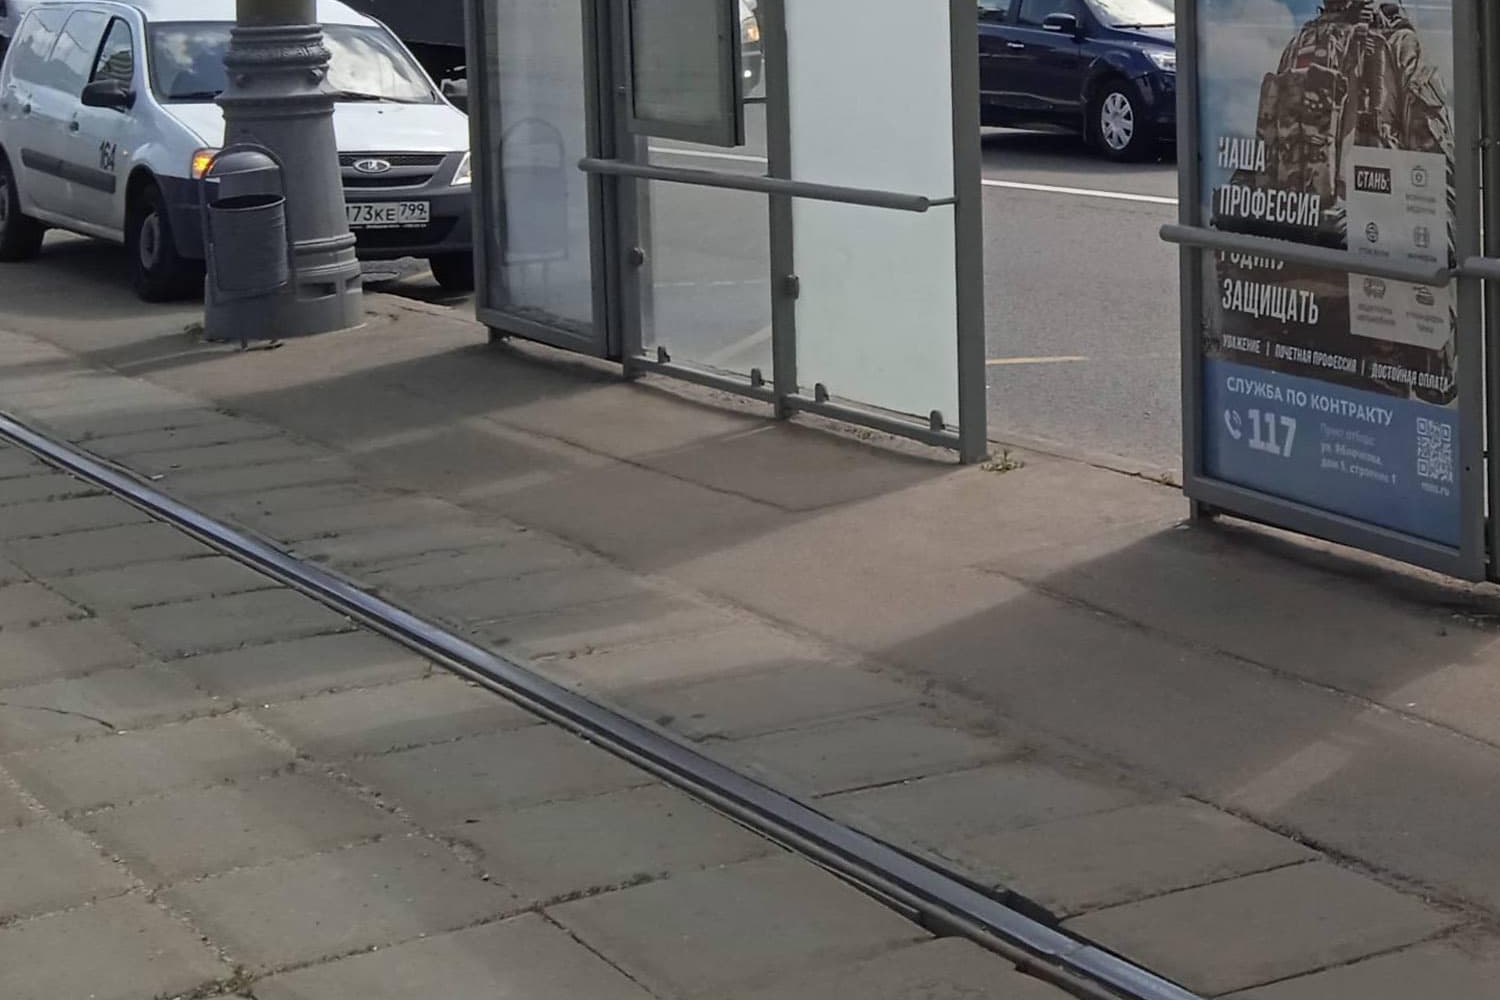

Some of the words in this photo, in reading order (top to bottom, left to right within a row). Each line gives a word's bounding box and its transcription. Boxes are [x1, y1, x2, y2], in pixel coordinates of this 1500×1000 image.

[1218, 136, 1266, 173] НАША
[1219, 184, 1321, 227] ПРОФЕССИЯ
[1221, 278, 1319, 325] ЗАЩИЩАТЬ
[1222, 334, 1261, 354] УВАЖЕНИЕ
[1312, 350, 1357, 373] ПРОФЕССИЯ
[1226, 376, 1284, 402] СЛУЖБА
[1286, 388, 1308, 407] ПО
[1311, 394, 1393, 427] КОНТРАКТУ
[1248, 408, 1297, 458] 117
